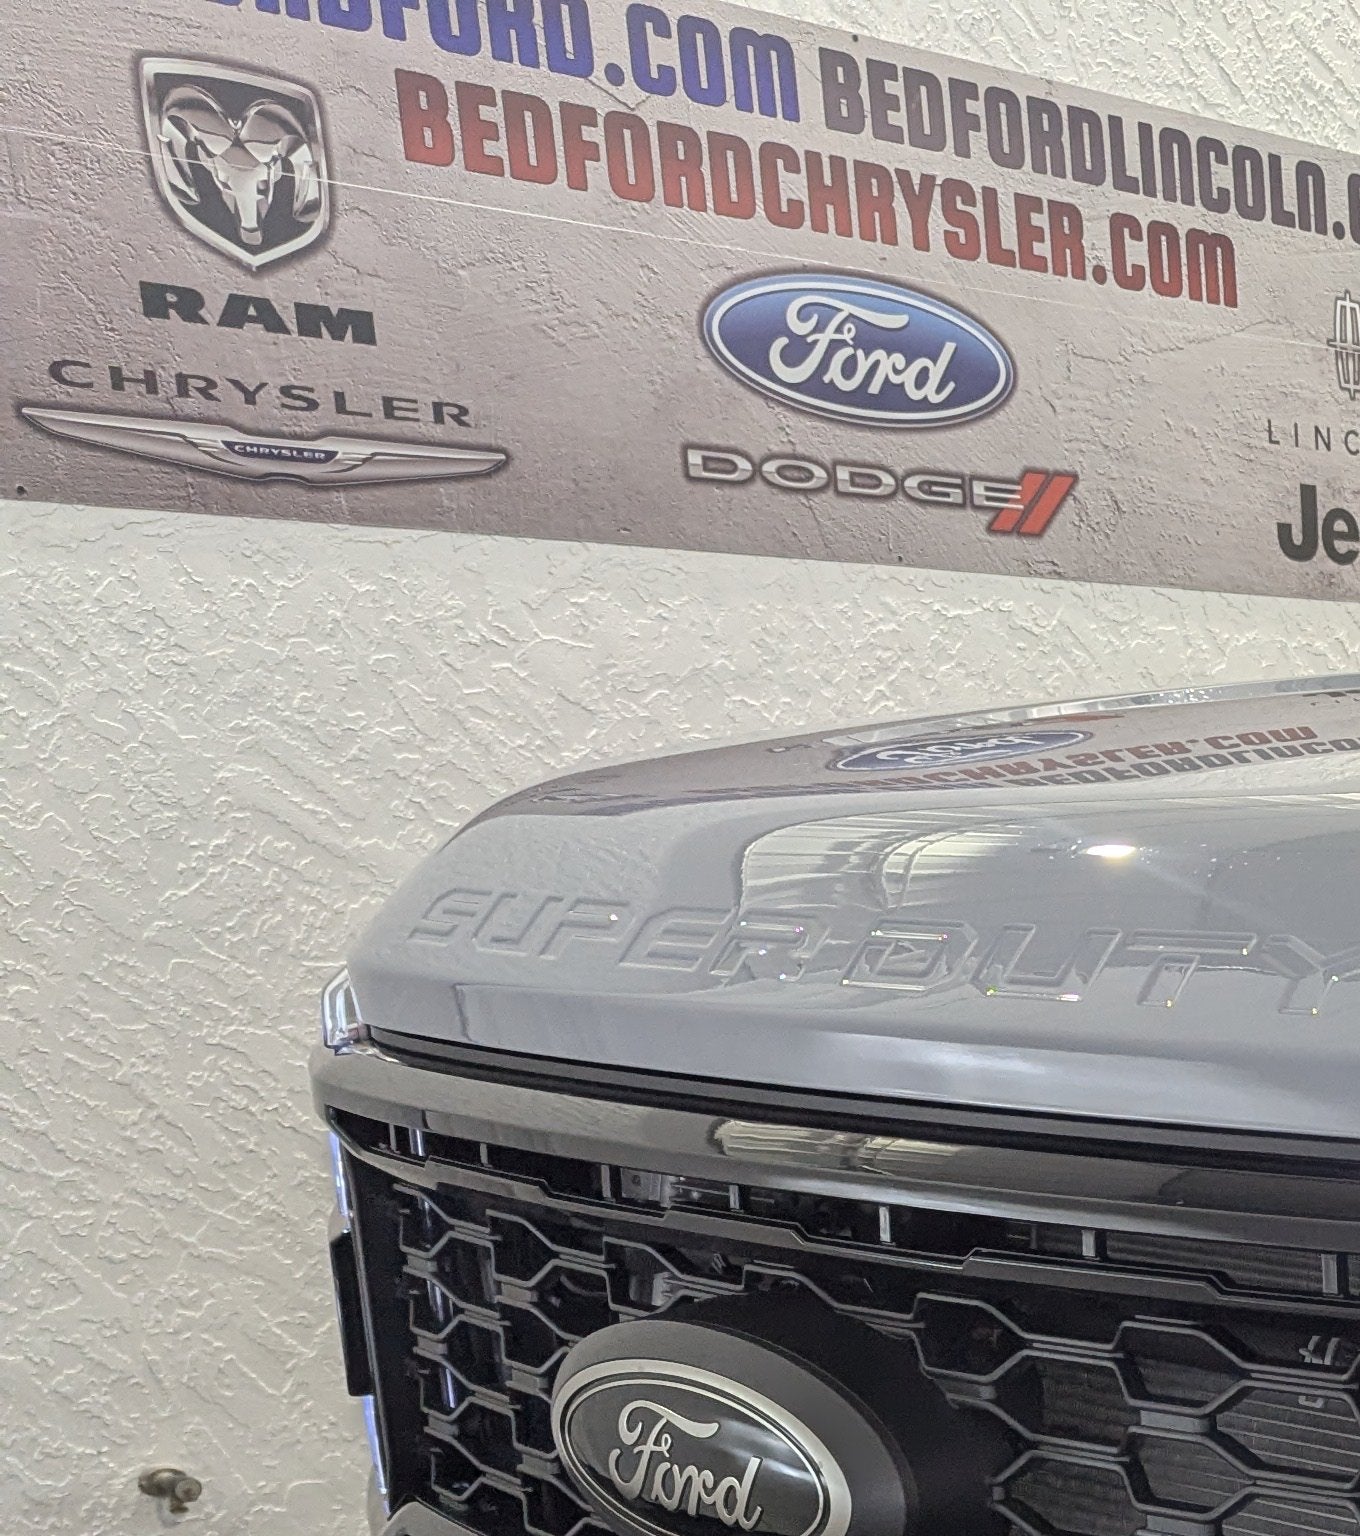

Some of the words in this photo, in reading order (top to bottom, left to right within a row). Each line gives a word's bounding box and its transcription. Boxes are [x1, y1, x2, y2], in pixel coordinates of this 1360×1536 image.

[394, 68, 1238, 309] BEDFORDCHRYSLER.COM
[139, 281, 378, 346] RAM
[769, 295, 957, 404] Ford
[48, 359, 471, 429] CHRYSLER
[234, 444, 326, 460] CHRYSLER
[686, 448, 1022, 511] DODGE
[407, 886, 824, 982] SUPER
[608, 1400, 764, 1531] Ford
